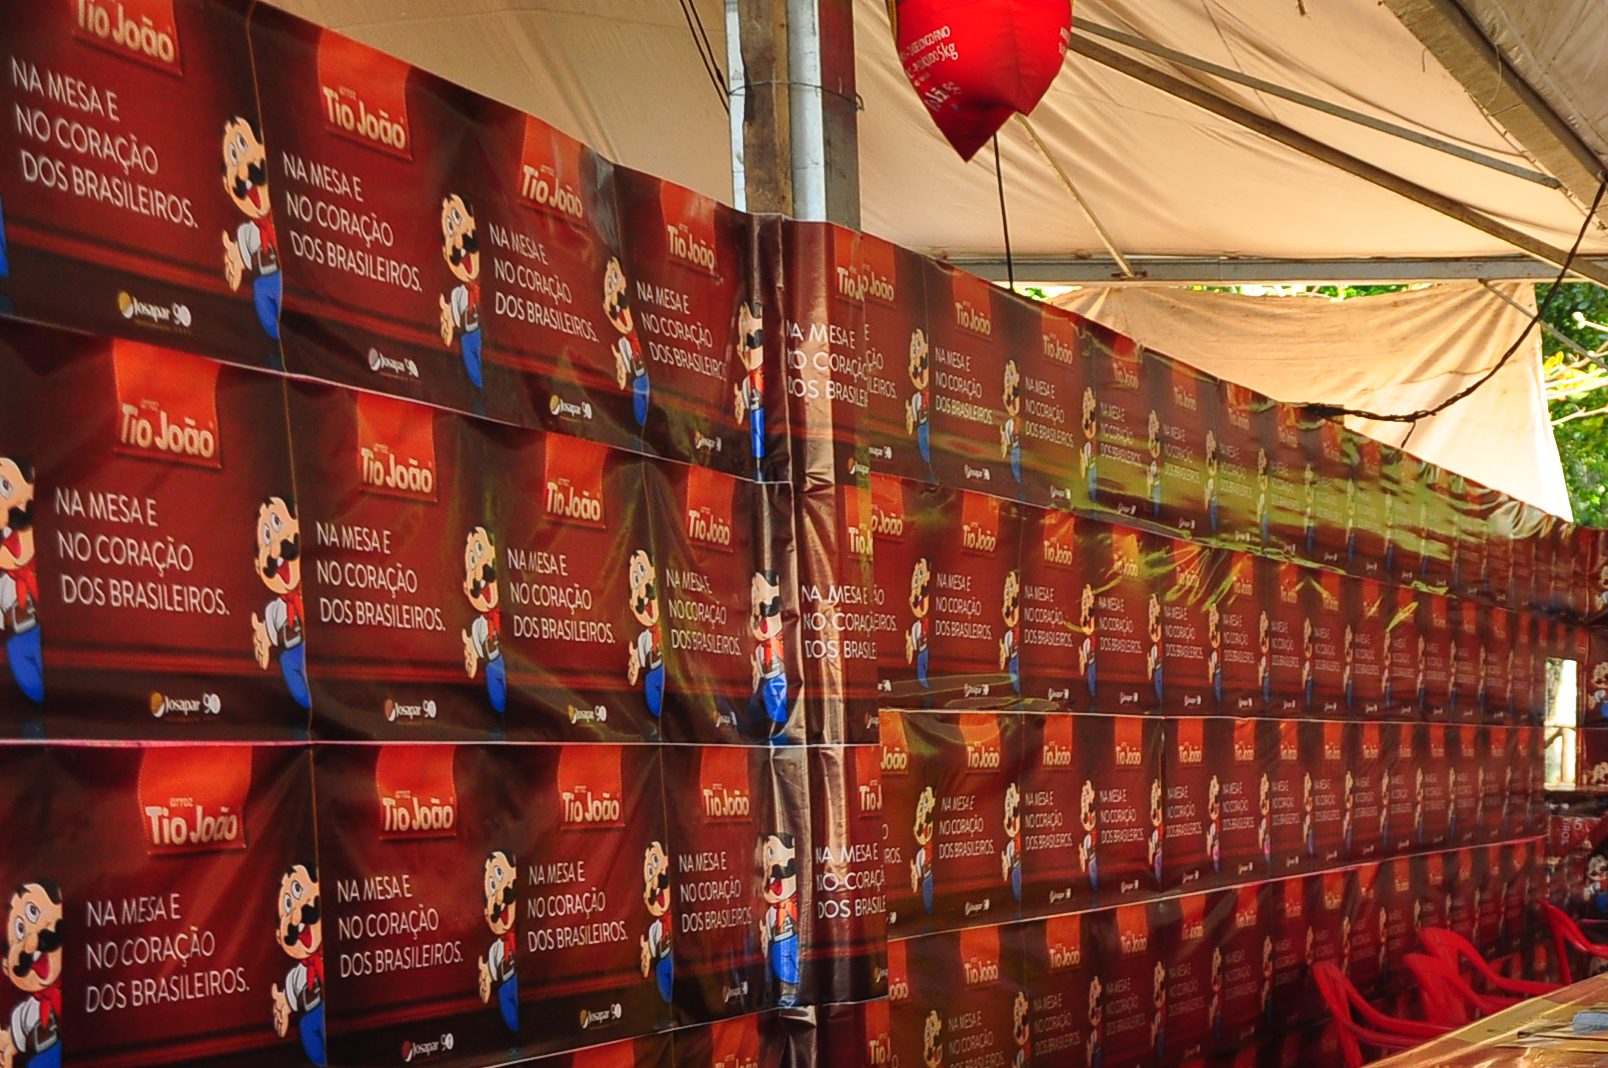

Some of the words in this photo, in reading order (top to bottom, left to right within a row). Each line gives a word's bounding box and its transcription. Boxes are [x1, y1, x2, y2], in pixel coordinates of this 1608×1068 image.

[74, 0, 110, 33] Tio
[113, 15, 174, 63] João
[12, 57, 44, 96] NA
[48, 71, 104, 116] MESA
[103, 90, 120, 122] E
[323, 87, 352, 130] Tio
[354, 101, 406, 150] João
[16, 104, 50, 142] NO
[56, 118, 158, 175] CORAÇÃO
[21, 150, 68, 191] DOS
[72, 165, 198, 228] BRASILEIROS.
[283, 152, 308, 183] NA
[310, 162, 351, 197] MESA
[351, 176, 364, 202] E
[522, 164, 549, 203] Tio
[550, 173, 583, 219] João
[286, 192, 312, 222] NO
[316, 202, 393, 248] CORAÇÃO
[290, 230, 324, 264] DOS
[327, 242, 422, 292] BRASILEIROS.
[489, 223, 510, 249] NA
[511, 231, 539, 260] MESA
[538, 244, 548, 265] E
[494, 258, 515, 284] NO
[517, 266, 572, 305] CORAÇÃO
[133, 301, 170, 322] Josapar
[496, 292, 525, 320] DOS
[527, 301, 599, 342] BRASILEIROS.
[955, 302, 968, 328] Tio
[969, 307, 991, 335] João
[935, 347, 945, 364] NA
[946, 351, 966, 369] MESA
[936, 372, 948, 389] NO
[949, 374, 982, 400] CORAÇÃO
[936, 395, 950, 412] DOS
[122, 404, 153, 447] Tio
[155, 414, 214, 458] João
[361, 447, 383, 487] Tio
[385, 458, 432, 493] João
[56, 488, 86, 517] NA
[90, 492, 143, 524] MESA
[146, 498, 158, 526] E
[546, 481, 565, 515] Tio
[566, 488, 601, 523] João
[58, 531, 91, 561] NO
[96, 535, 193, 577] CORAÇÃO
[316, 522, 339, 547] NA
[342, 526, 381, 552] MESA
[383, 530, 391, 554] E
[317, 560, 342, 585] NO
[345, 563, 417, 598] CORAÇÃO
[508, 548, 526, 569] NA
[529, 552, 559, 574] MESA
[560, 555, 568, 576] E
[61, 574, 105, 606] DOS
[109, 579, 230, 615] BRASILEIROS.
[510, 582, 529, 604] NO
[532, 584, 592, 615] CORAÇÃO
[320, 598, 353, 624] DOS
[356, 601, 446, 631] BRASILEIROS.
[514, 615, 539, 638] DOS
[541, 618, 615, 643] BRASILEIROS.
[165, 693, 200, 713] Josapar
[395, 702, 422, 718] Josapar
[383, 797, 410, 833] Tio
[413, 797, 453, 830] João
[563, 792, 583, 823] Tio
[586, 793, 620, 822] João
[146, 807, 185, 846] Tio
[188, 807, 238, 843] João
[337, 880, 360, 902] NA
[364, 876, 402, 900] MESA
[402, 875, 412, 897] E
[530, 866, 547, 885] NA
[548, 863, 576, 883] MESA
[578, 861, 586, 882] E
[88, 900, 118, 927] NA
[122, 896, 167, 924] MESA
[170, 893, 181, 919] E
[528, 897, 546, 918] NO
[549, 887, 605, 919] CORAÇÃO
[339, 916, 363, 940] NO
[367, 904, 438, 940] CORAÇÃO
[528, 929, 554, 952] DOS
[556, 921, 628, 948] BRASILEIROS.
[87, 942, 117, 970] NO
[122, 926, 215, 967] CORAÇÃO
[341, 952, 372, 978] DOS
[376, 941, 463, 973] BRASILEIROS.
[86, 982, 126, 1012] DOS
[132, 967, 250, 1006] BRASILEIROS.
[413, 1042, 439, 1057] Josapar
